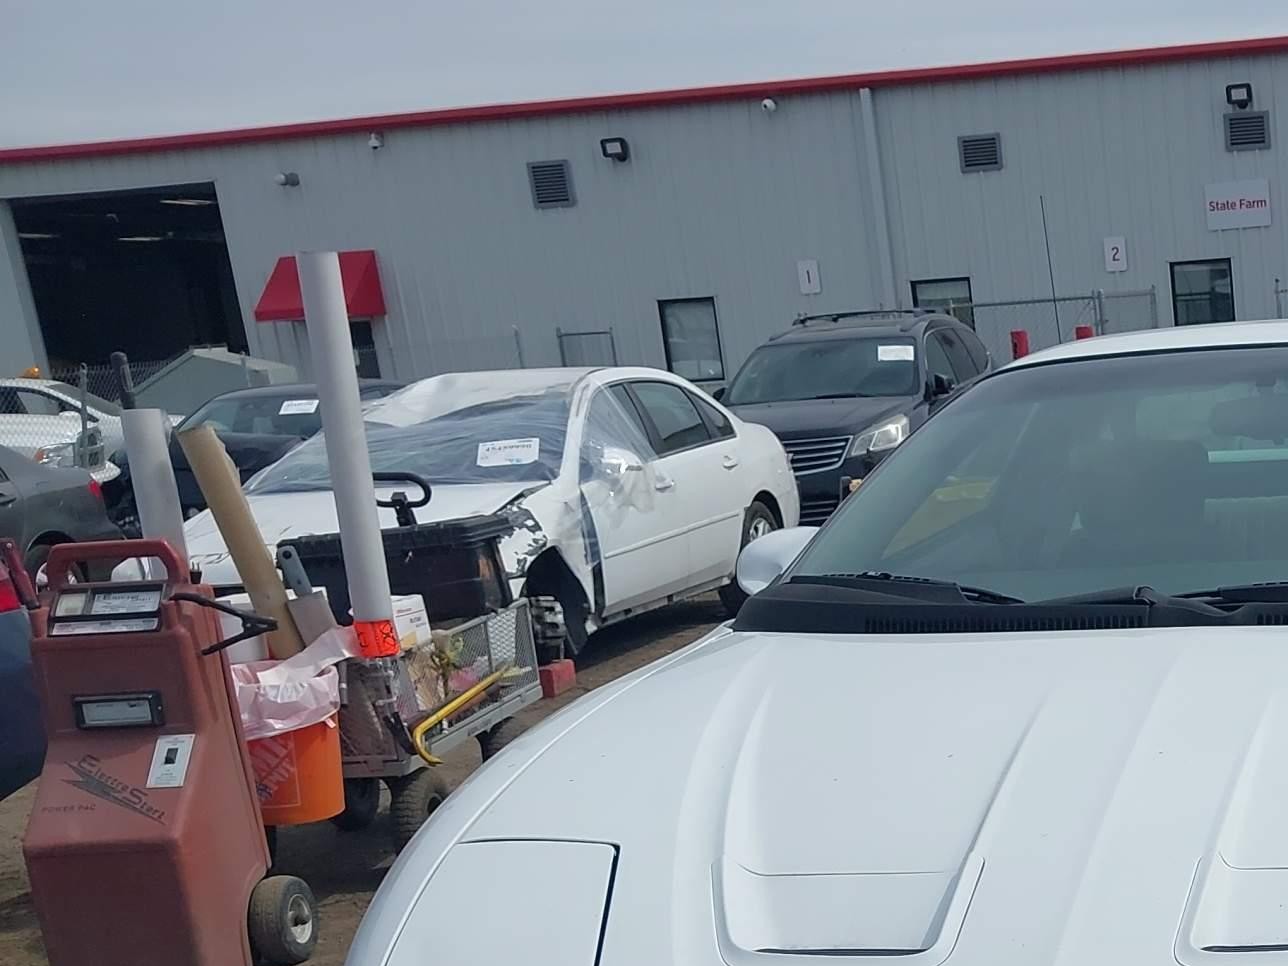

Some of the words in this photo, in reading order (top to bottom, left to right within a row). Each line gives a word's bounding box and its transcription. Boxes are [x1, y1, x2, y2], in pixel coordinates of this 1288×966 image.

[1208, 200, 1237, 212] State
[1239, 198, 1267, 210] Farm
[1111, 246, 1121, 262] 2
[806, 269, 812, 284] 1
